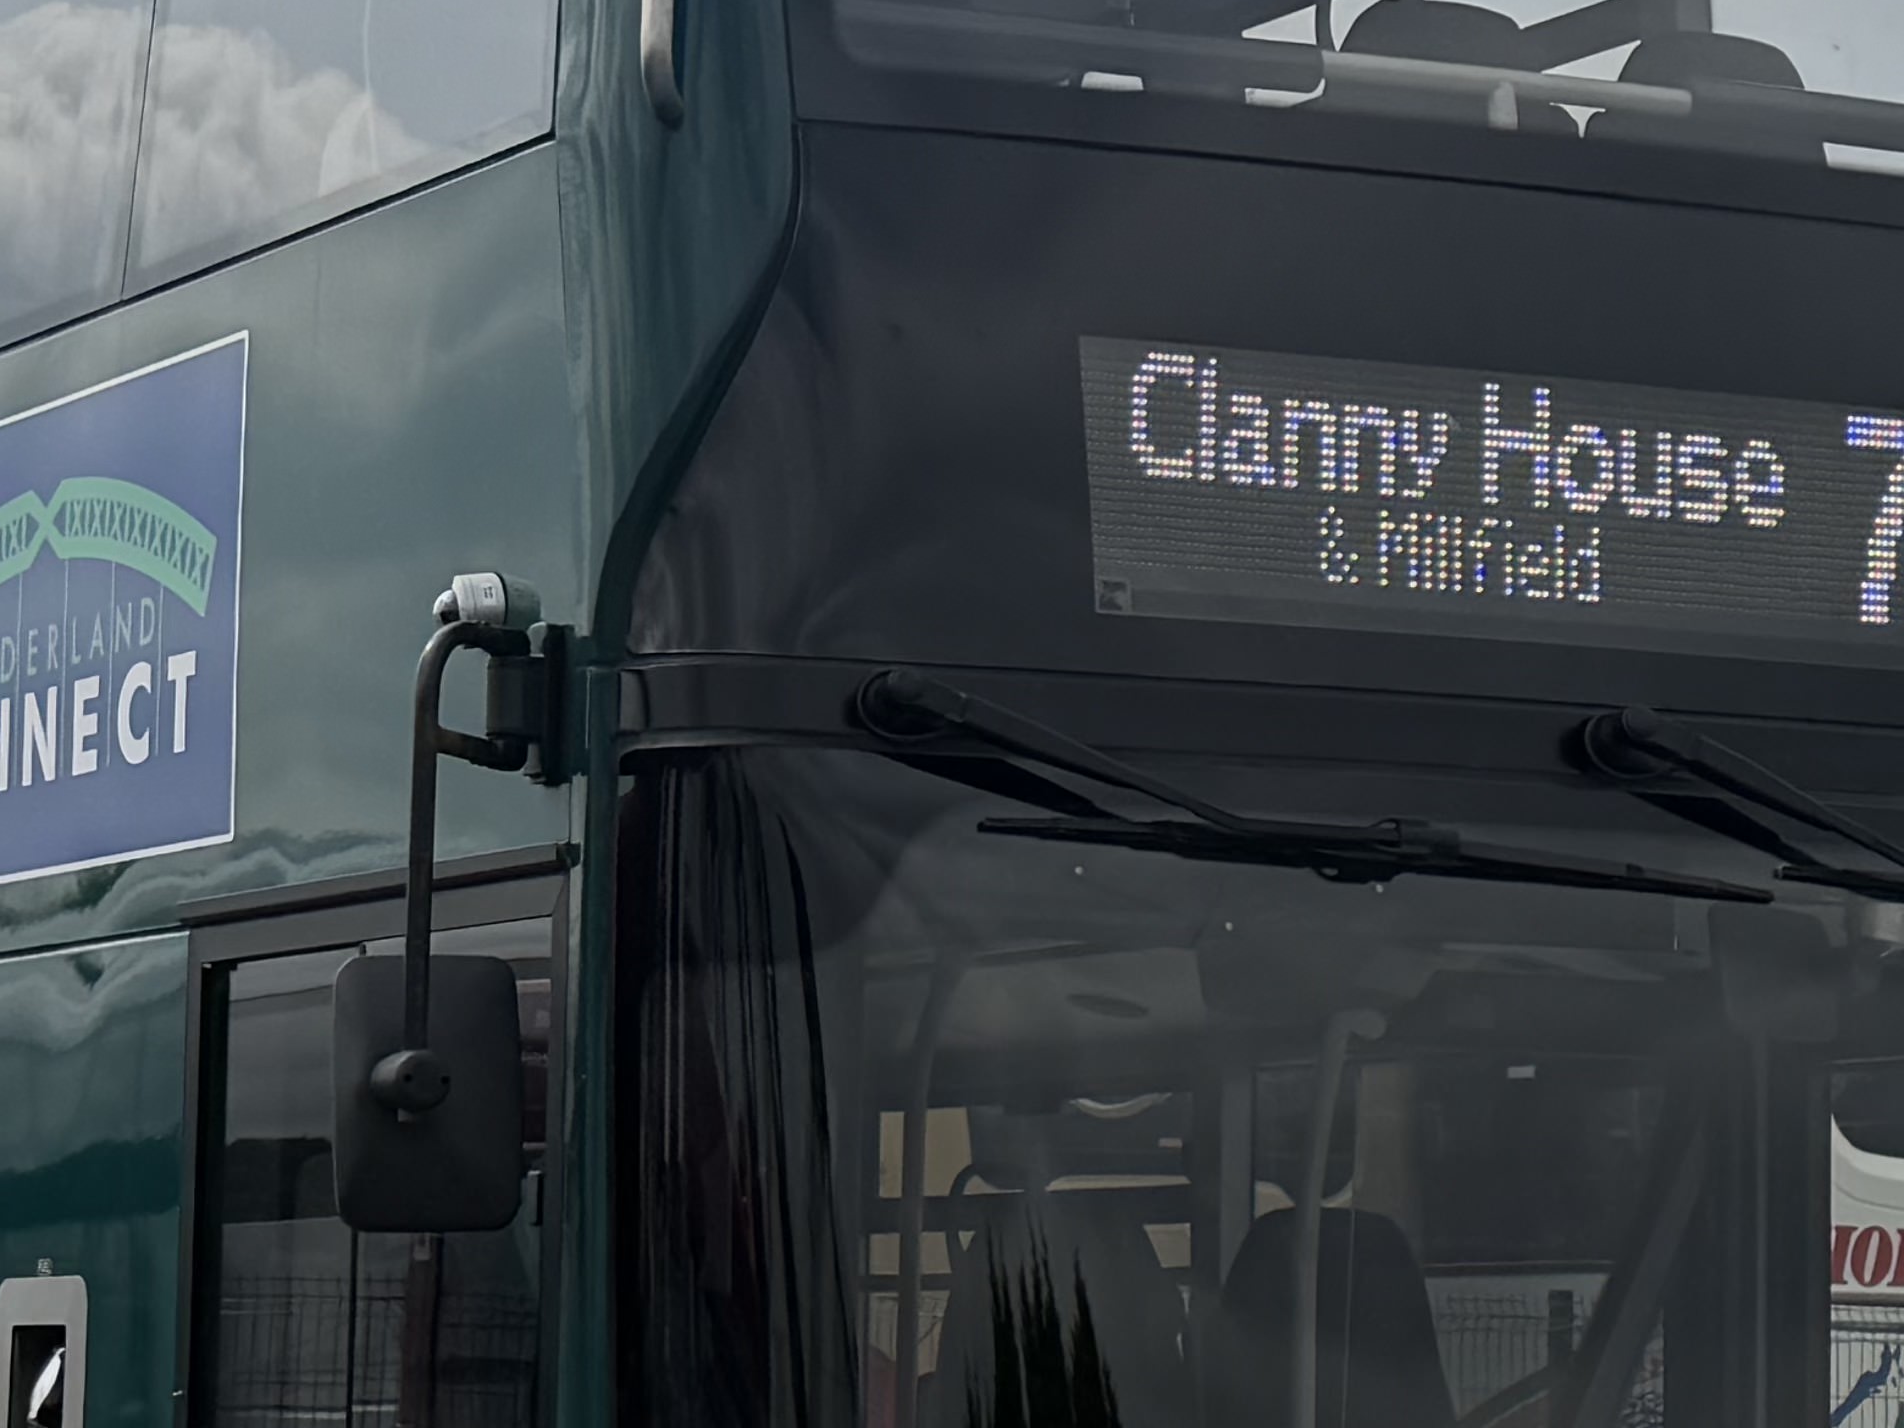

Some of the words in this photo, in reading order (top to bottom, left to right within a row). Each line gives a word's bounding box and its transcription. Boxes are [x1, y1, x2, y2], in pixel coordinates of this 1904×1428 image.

[1130, 351, 1450, 499] Clanny
[1482, 381, 1786, 528] House
[1318, 504, 1360, 584] &
[1379, 509, 1602, 603] Millfield
